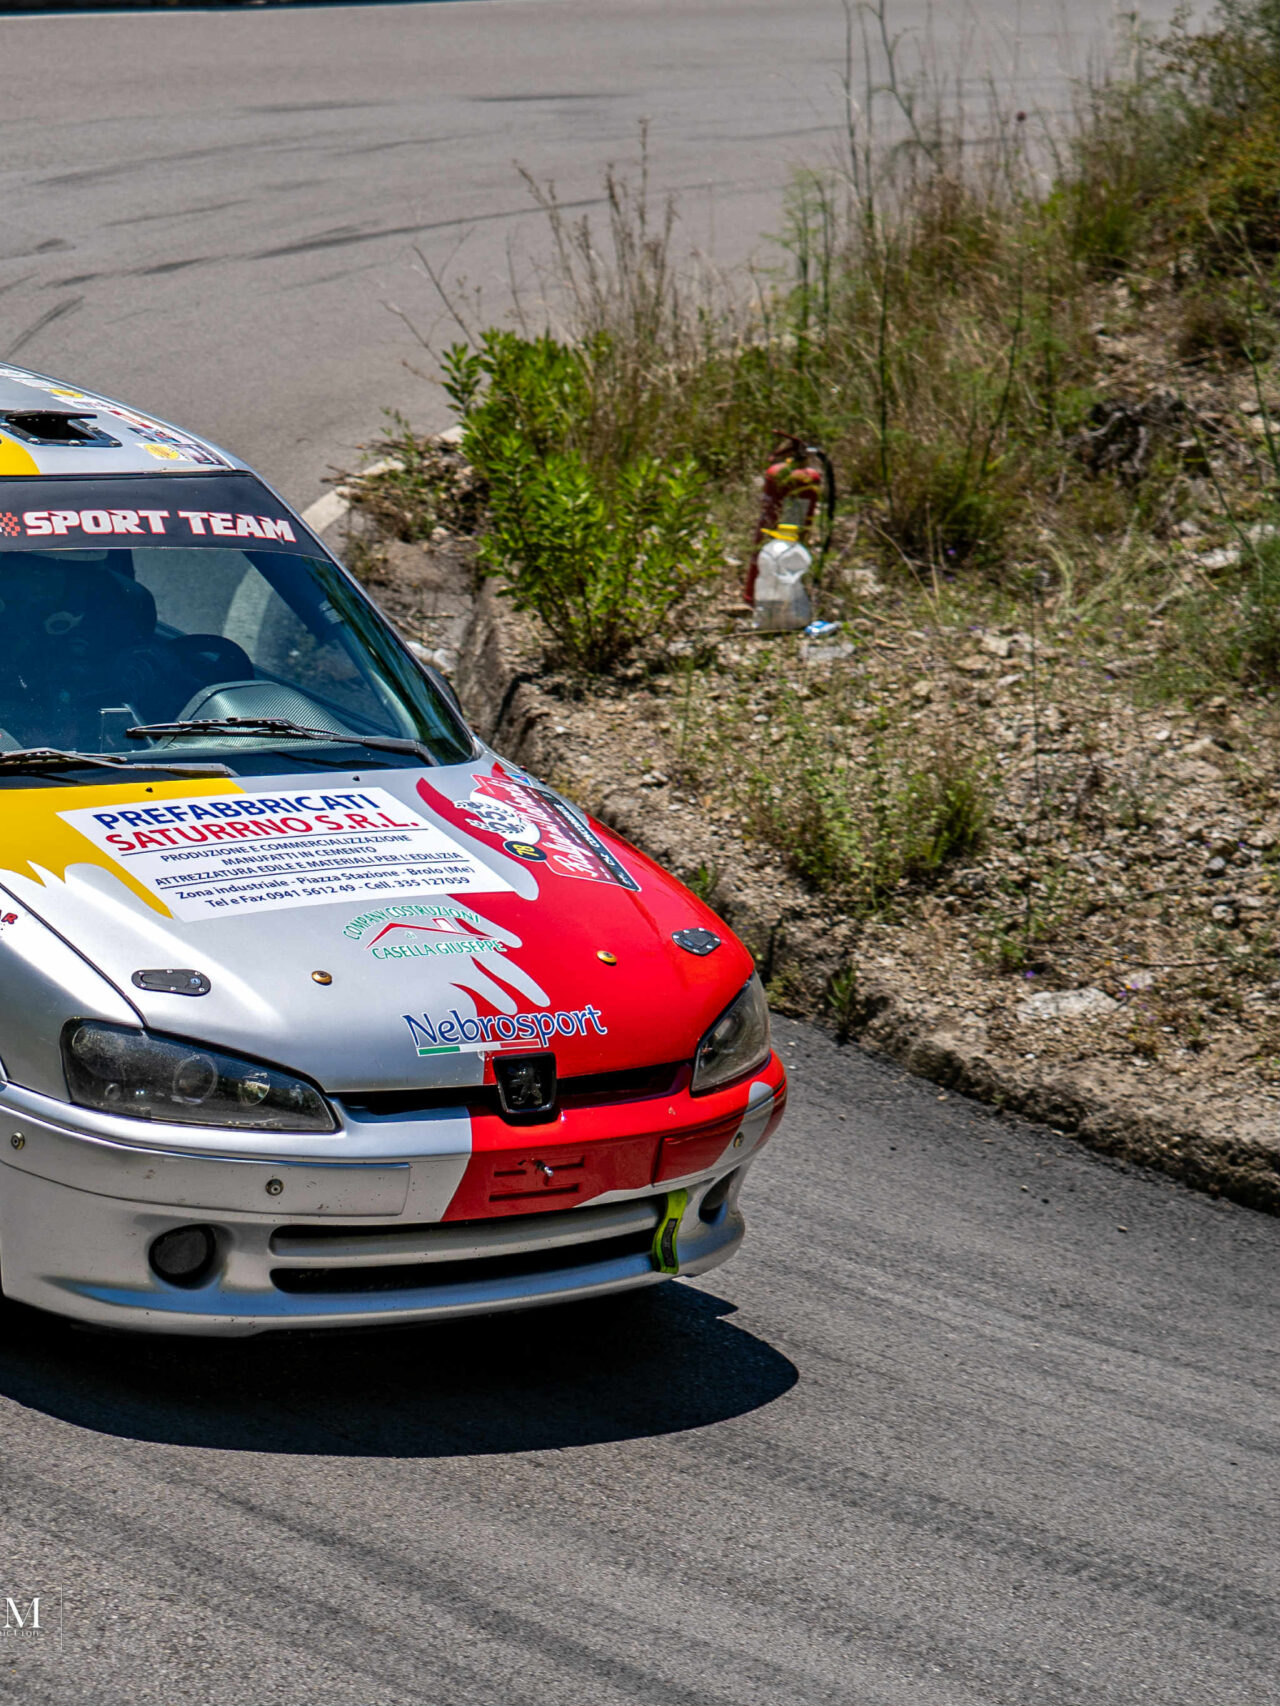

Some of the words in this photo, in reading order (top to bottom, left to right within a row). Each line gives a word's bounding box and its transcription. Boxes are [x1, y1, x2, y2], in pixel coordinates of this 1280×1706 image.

[21, 509, 171, 537] SPORT
[178, 510, 298, 543] TEAM
[92, 793, 380, 830] PREFABBRICATI
[105, 816, 313, 851] SATURRNO
[314, 812, 420, 831] S.R.L.
[160, 845, 251, 862] PRODUZIONE
[250, 845, 261, 853] E
[261, 834, 412, 851] COMMERCIALIZZAZIONE
[222, 852, 299, 866] MANUFATTI
[300, 849, 314, 859] IN
[315, 846, 377, 858] CEMENTO
[511, 843, 540, 857] 78
[154, 866, 256, 886] ATTREZZATURA
[257, 861, 295, 873] EDILE
[296, 861, 307, 870] E
[307, 855, 376, 869] MATERIALI
[375, 854, 400, 864] PER
[400, 851, 464, 862] L'EDILIZIA
[175, 887, 214, 900] Zona
[215, 878, 289, 896] industriale
[296, 873, 341, 886] Piazza
[340, 869, 400, 882] Stazione
[406, 866, 444, 877] Brolo
[443, 864, 476, 876] (Me)
[205, 896, 229, 909] Tel
[229, 896, 240, 905] e
[241, 893, 267, 904] Fax
[267, 889, 301, 901] 0941
[302, 885, 338, 897] 5612
[338, 883, 357, 893] 49
[364, 879, 396, 891] Cell.
[396, 878, 421, 889] 335
[421, 875, 471, 887] 127059
[342, 908, 390, 940] COMPANY
[386, 904, 481, 924] COSTRUZIONI
[371, 943, 437, 960] CASELLA
[435, 939, 508, 955] GIUSEPPE
[401, 1004, 608, 1048] Nebrosport
